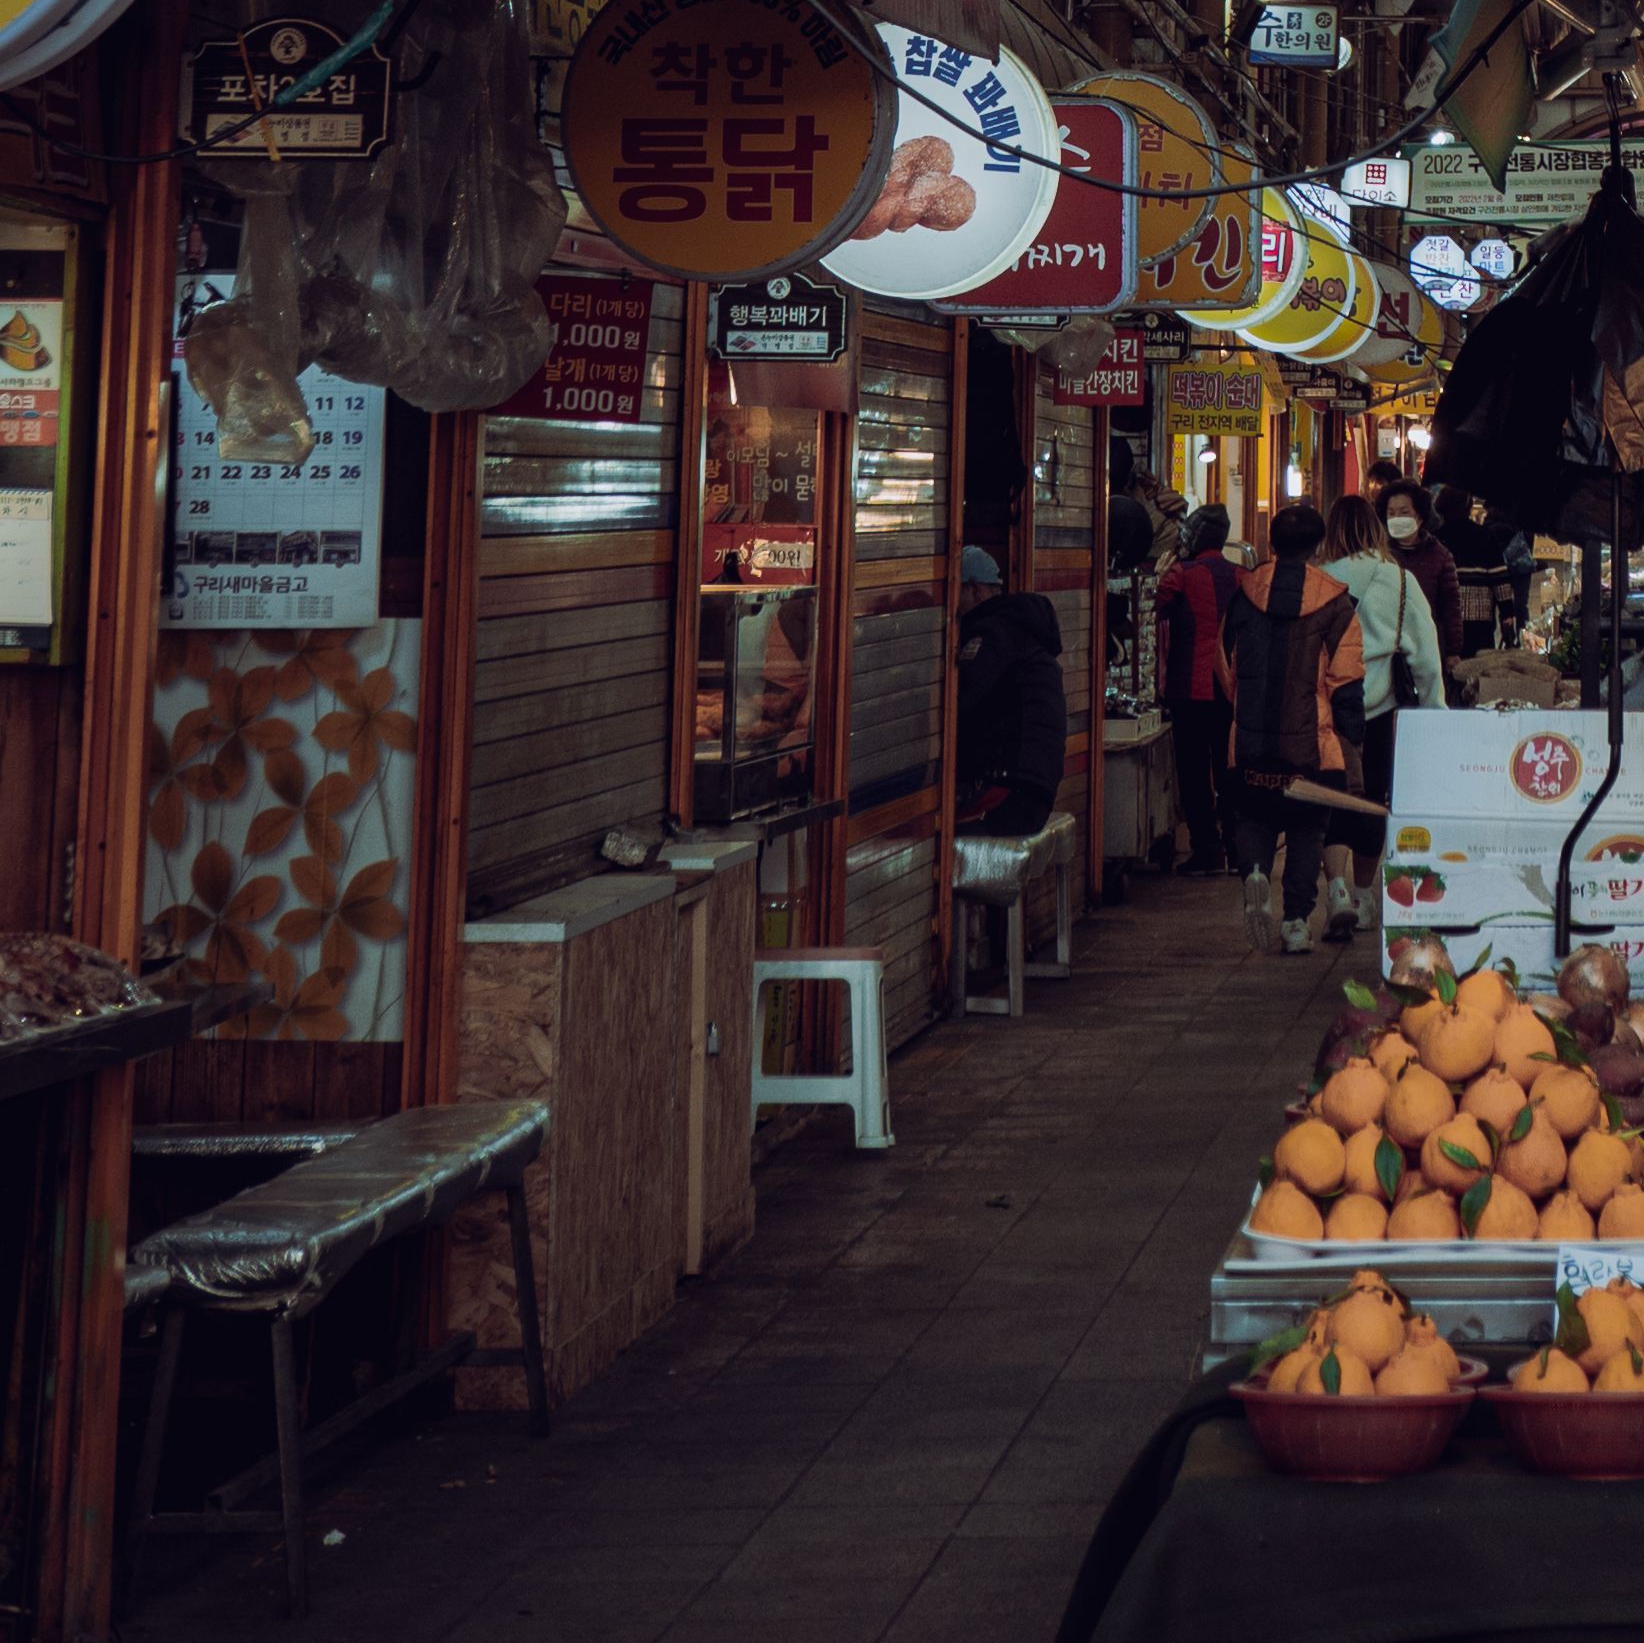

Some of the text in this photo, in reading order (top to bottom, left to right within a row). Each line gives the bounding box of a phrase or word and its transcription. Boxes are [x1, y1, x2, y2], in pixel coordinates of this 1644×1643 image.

[1274, 31, 1332, 51] 한의원
[650, 42, 792, 105] 착한
[905, 35, 1021, 173] 찹쌀 꽈배기
[613, 115, 829, 222] 통닭
[1424, 155, 1462, 174] 2022
[1353, 190, 1397, 204] 다이소
[1425, 238, 1450, 252] 젓갈
[1480, 245, 1504, 260] 일등
[551, 294, 591, 317] 다리
[729, 304, 827, 327] 행복꽈배기
[1171, 372, 1262, 410] 떡볶이 순대
[315, 397, 364, 411] 11 12
[1171, 414, 1259, 431] 구리 전지역 배달
[194, 431, 215, 445] 14
[342, 431, 363, 445] 19
[191, 466, 361, 480] 21 22 23 24 25 26
[189, 500, 210, 514] 28
[193, 576, 309, 594] 구리새마을금고
[1528, 777, 1562, 795] 참외
